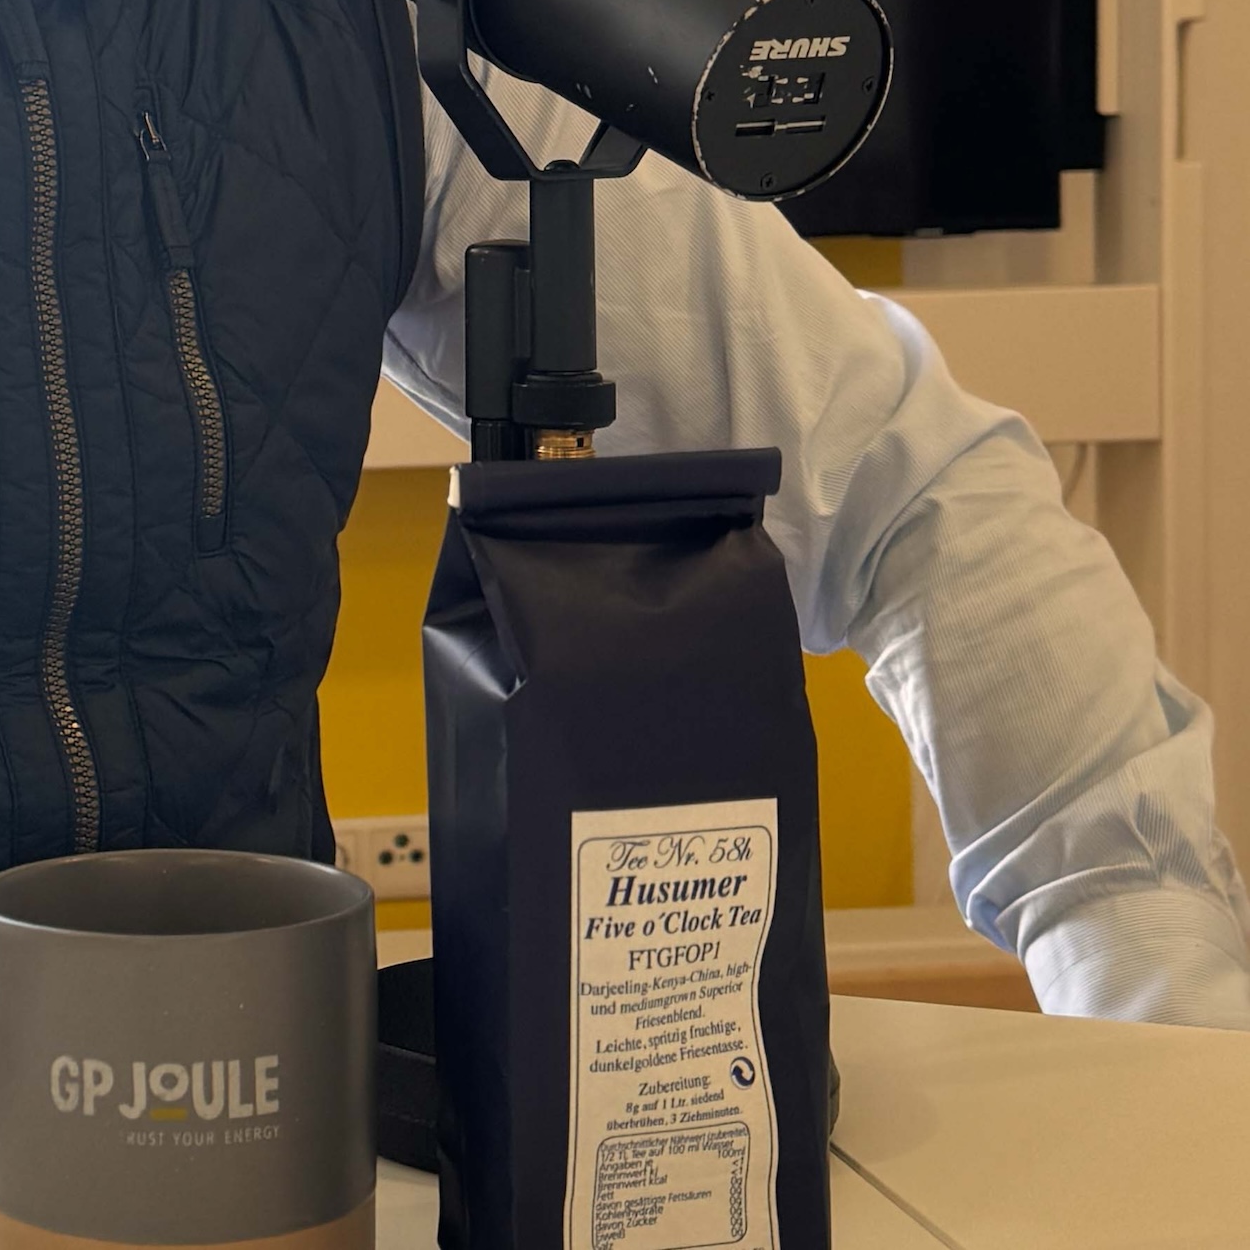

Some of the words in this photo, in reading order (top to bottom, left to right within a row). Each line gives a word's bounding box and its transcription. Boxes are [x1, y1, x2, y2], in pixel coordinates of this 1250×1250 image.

[749, 36, 851, 61] SHURE
[606, 839, 651, 872] Tee
[654, 835, 706, 869] Nr.
[709, 837, 754, 864] 58h
[606, 874, 748, 907] Husumer
[584, 916, 636, 940] Five
[728, 905, 763, 927] Tea
[628, 941, 721, 971] FTGFOP1
[579, 968, 725, 999] Darjeeling-Kenya-China,
[726, 962, 753, 979] high-
[590, 1001, 617, 1016] und
[620, 990, 697, 1014] mediumgrown
[699, 981, 744, 1000] Superior
[635, 1007, 706, 1030] Friesenblend.
[596, 1037, 647, 1054] Leichte,
[648, 1027, 687, 1050] spritzig
[690, 1018, 742, 1040] fruchtige,
[589, 1053, 678, 1074] dunkelgoldene
[679, 1039, 749, 1061] Friesentasse.
[51, 1055, 114, 1116] GP
[118, 1053, 280, 1120] JOULE
[625, 1101, 640, 1114] 8g
[642, 1098, 659, 1112] auf
[691, 1089, 725, 1105] siedend
[670, 1113, 678, 1125] 3
[172, 1132, 215, 1147] YOUR
[224, 1125, 281, 1145] ENERGY
[668, 1143, 686, 1156] 100
